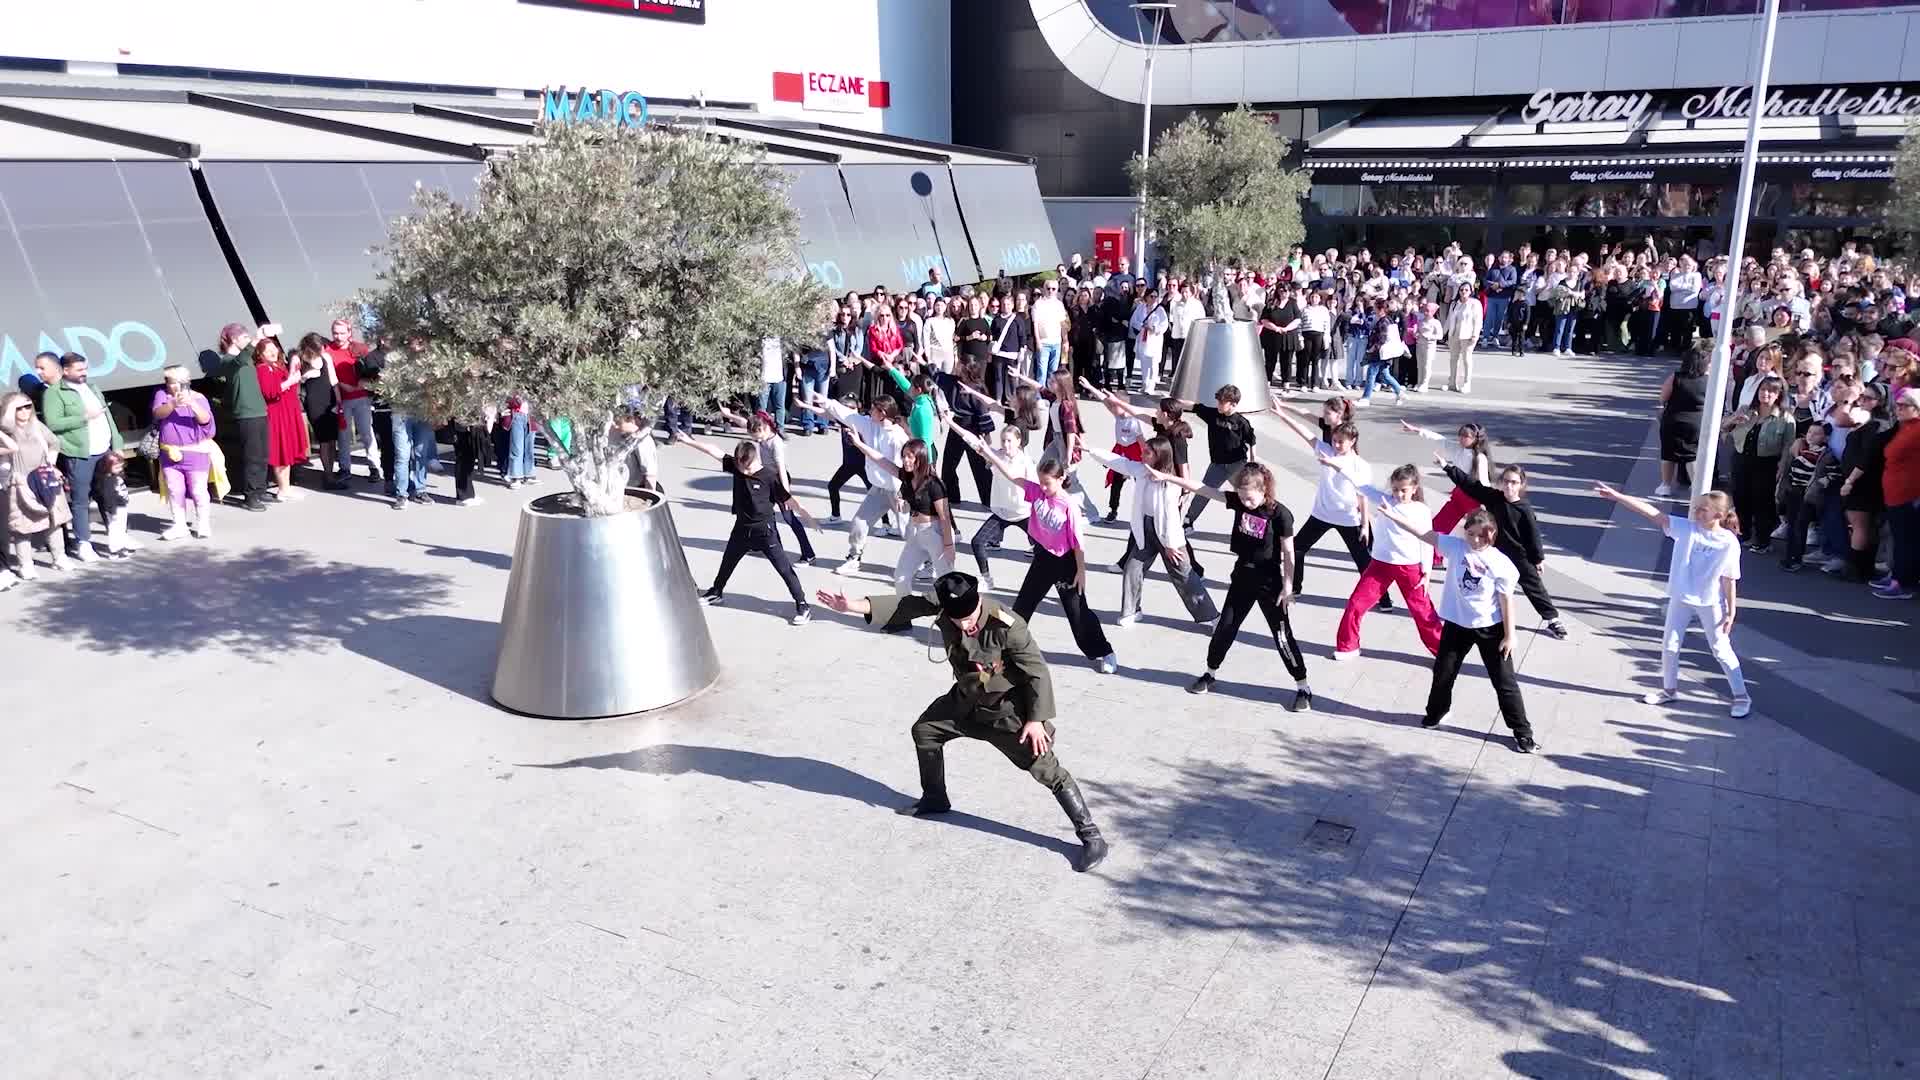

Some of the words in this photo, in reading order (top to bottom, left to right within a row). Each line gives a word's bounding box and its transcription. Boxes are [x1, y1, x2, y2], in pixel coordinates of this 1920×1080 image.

[808, 72, 865, 95] ECZANE
[543, 86, 648, 129] MADO
[1521, 87, 1653, 132] Saray
